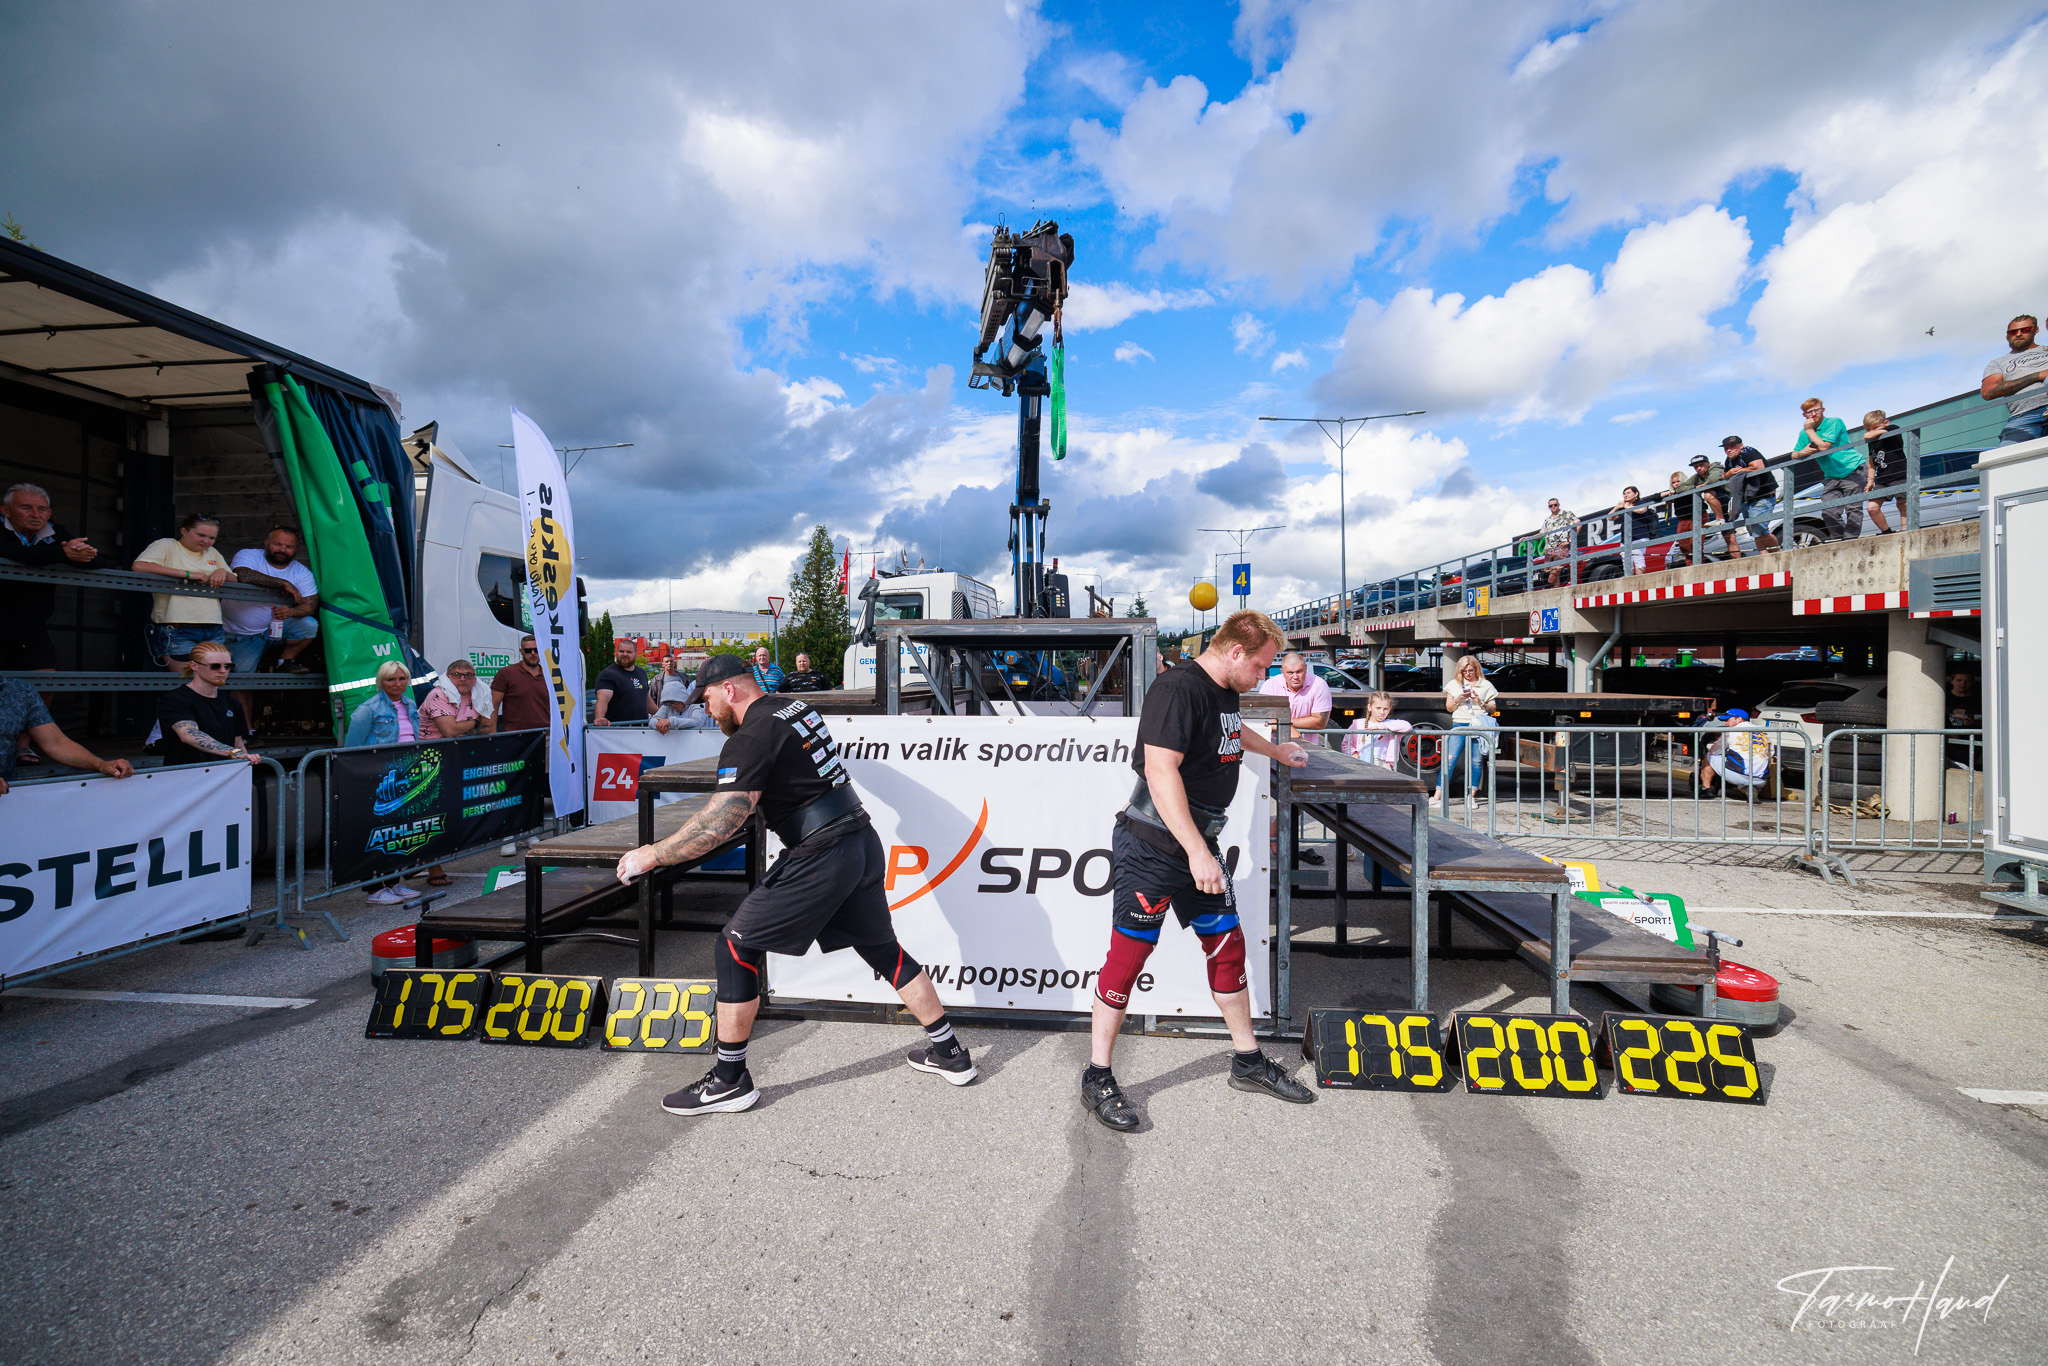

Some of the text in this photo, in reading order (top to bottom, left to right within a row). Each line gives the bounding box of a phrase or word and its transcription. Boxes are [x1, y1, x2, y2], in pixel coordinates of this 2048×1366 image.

[1236, 571, 1247, 587] 4
[900, 737, 969, 761] valik
[462, 760, 525, 780] ENGINEERING
[600, 767, 634, 789] 24
[462, 780, 507, 801] HUMAN
[370, 816, 441, 847] ATHLETE
[386, 833, 427, 851] BYTES
[1634, 916, 1672, 925] SPORT!
[392, 973, 477, 1036] 175
[484, 975, 592, 1042] 200
[605, 982, 712, 1047] 225
[1344, 1014, 1443, 1087] 175
[1466, 1016, 1598, 1092] 200
[1618, 1019, 1759, 1098] 225
